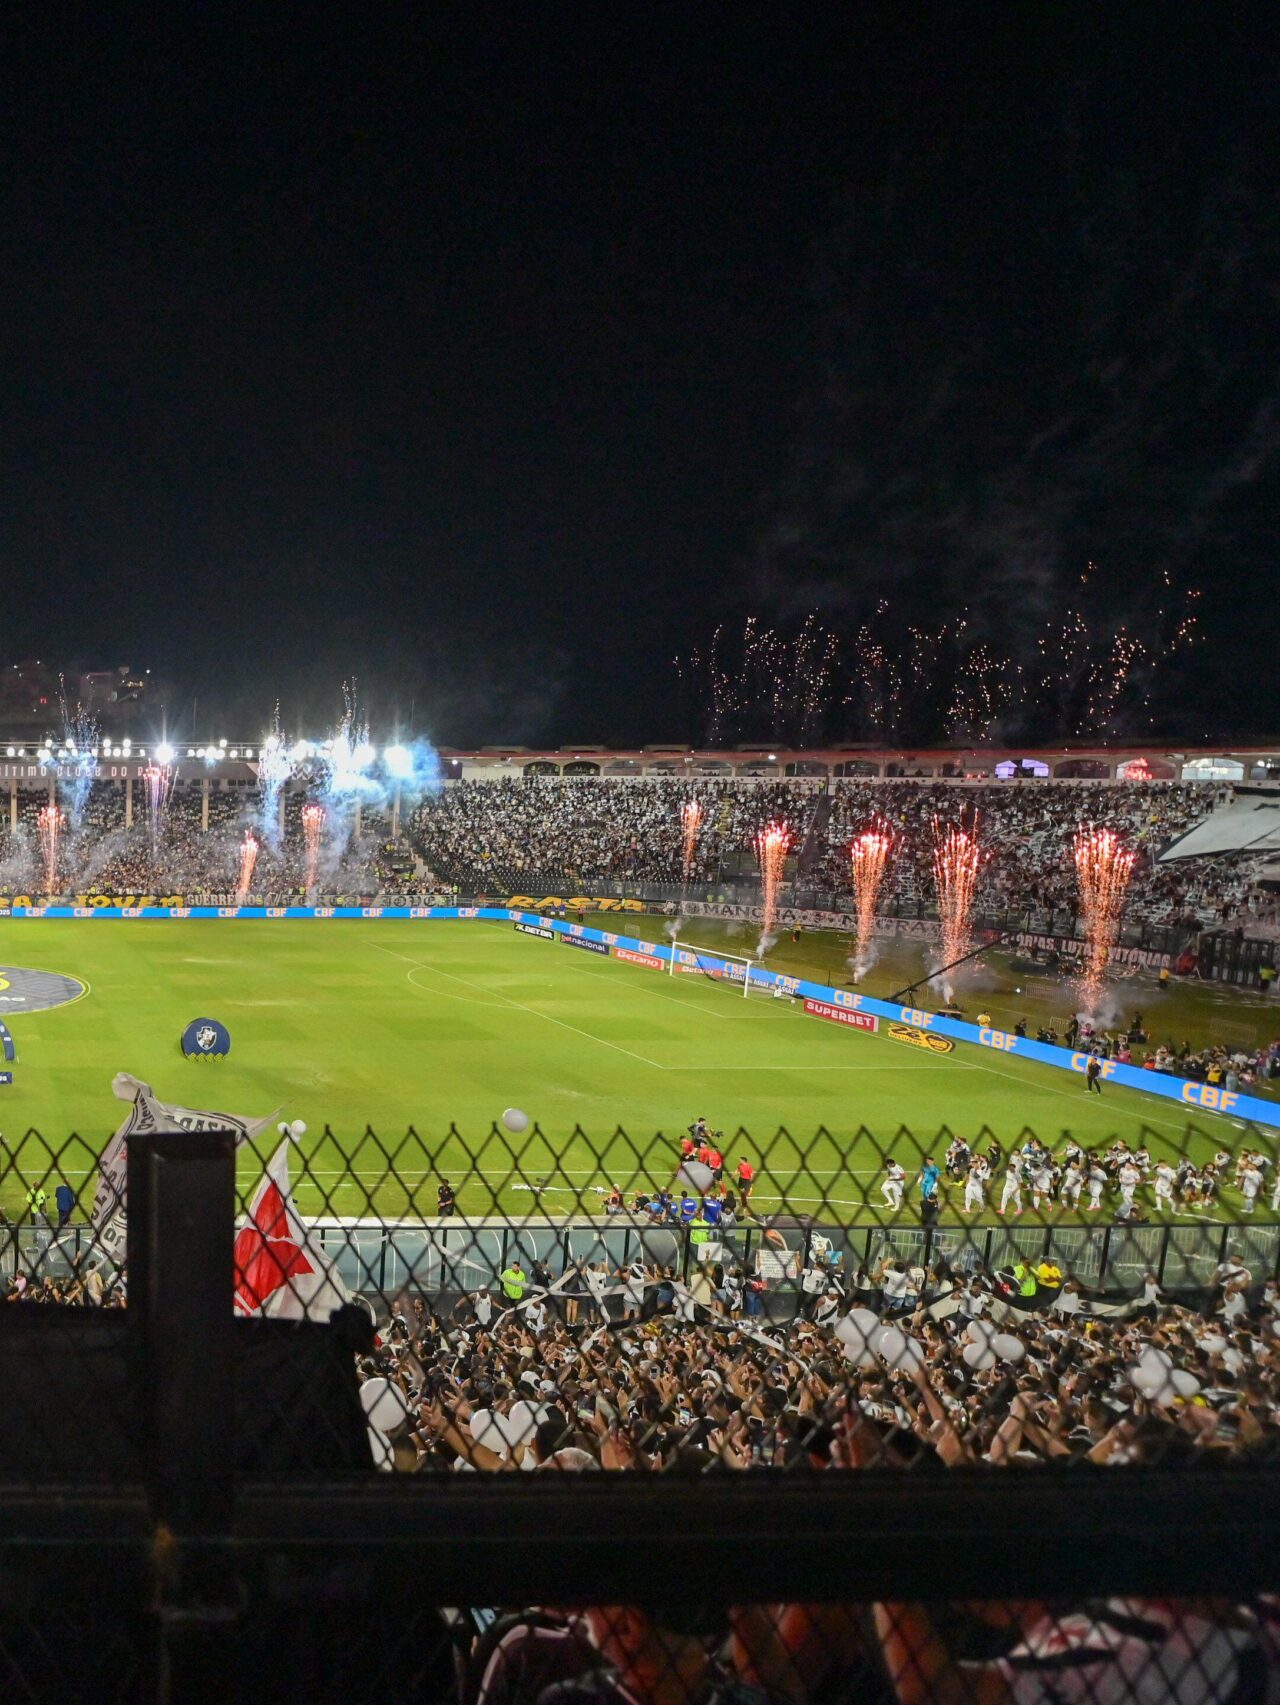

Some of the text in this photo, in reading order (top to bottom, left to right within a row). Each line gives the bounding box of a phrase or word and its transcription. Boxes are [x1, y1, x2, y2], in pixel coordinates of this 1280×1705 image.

[25, 907, 47, 917] CBF
[74, 907, 95, 917] CBF
[122, 907, 144, 917] CBF
[170, 907, 191, 917] CBF
[218, 907, 239, 917] CBF
[266, 908, 287, 917] CBF
[314, 908, 335, 917] CBF
[362, 908, 384, 917] CBF
[410, 908, 431, 917] CBF
[458, 908, 479, 918] CBF
[602, 932, 619, 945] CBF
[639, 941, 656, 955] CBF
[834, 990, 864, 1009] CBF
[806, 1002, 872, 1027] SUPERBET
[901, 1008, 935, 1029] CBF
[979, 1028, 1018, 1051] CBF
[1182, 1082, 1238, 1110] CBF
